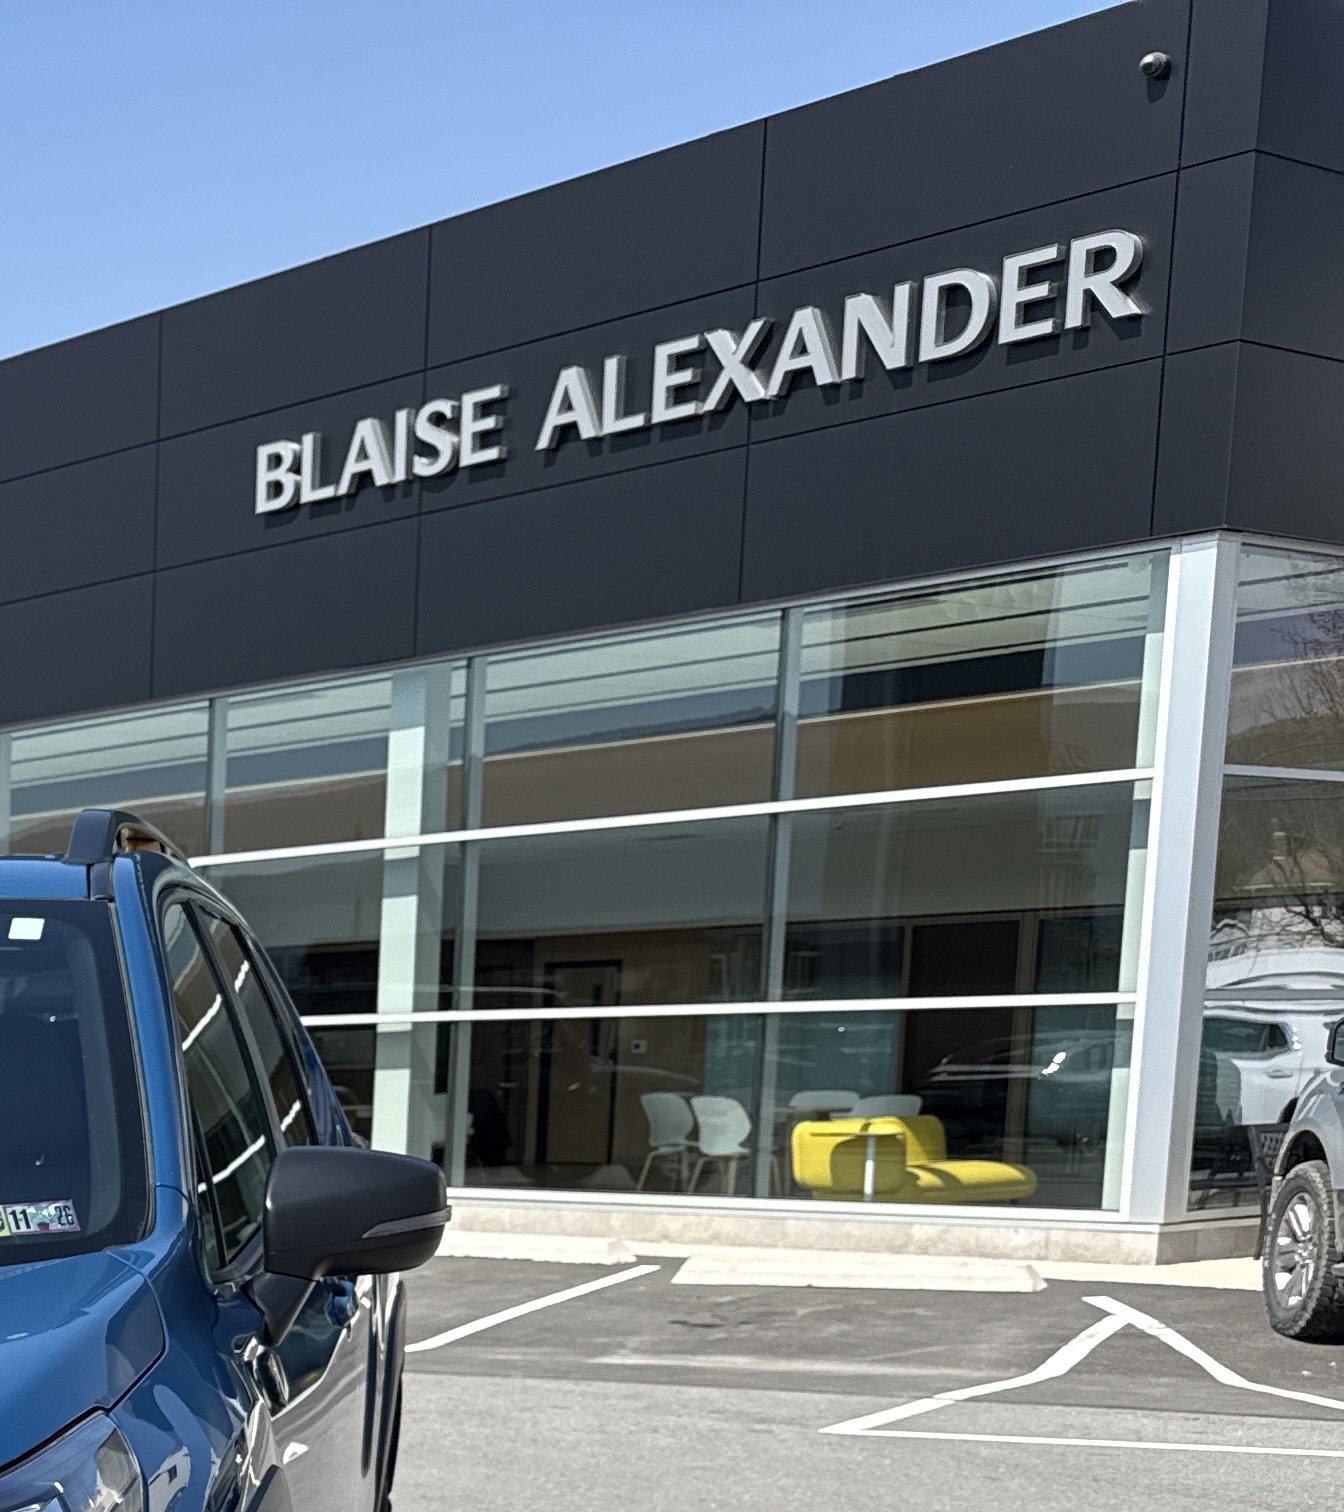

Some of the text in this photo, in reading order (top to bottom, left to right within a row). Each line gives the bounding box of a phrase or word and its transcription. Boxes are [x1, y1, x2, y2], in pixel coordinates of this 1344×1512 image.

[255, 229, 1146, 514] BLAISE ALEXANDER
[9, 1205, 75, 1230] 11 26
